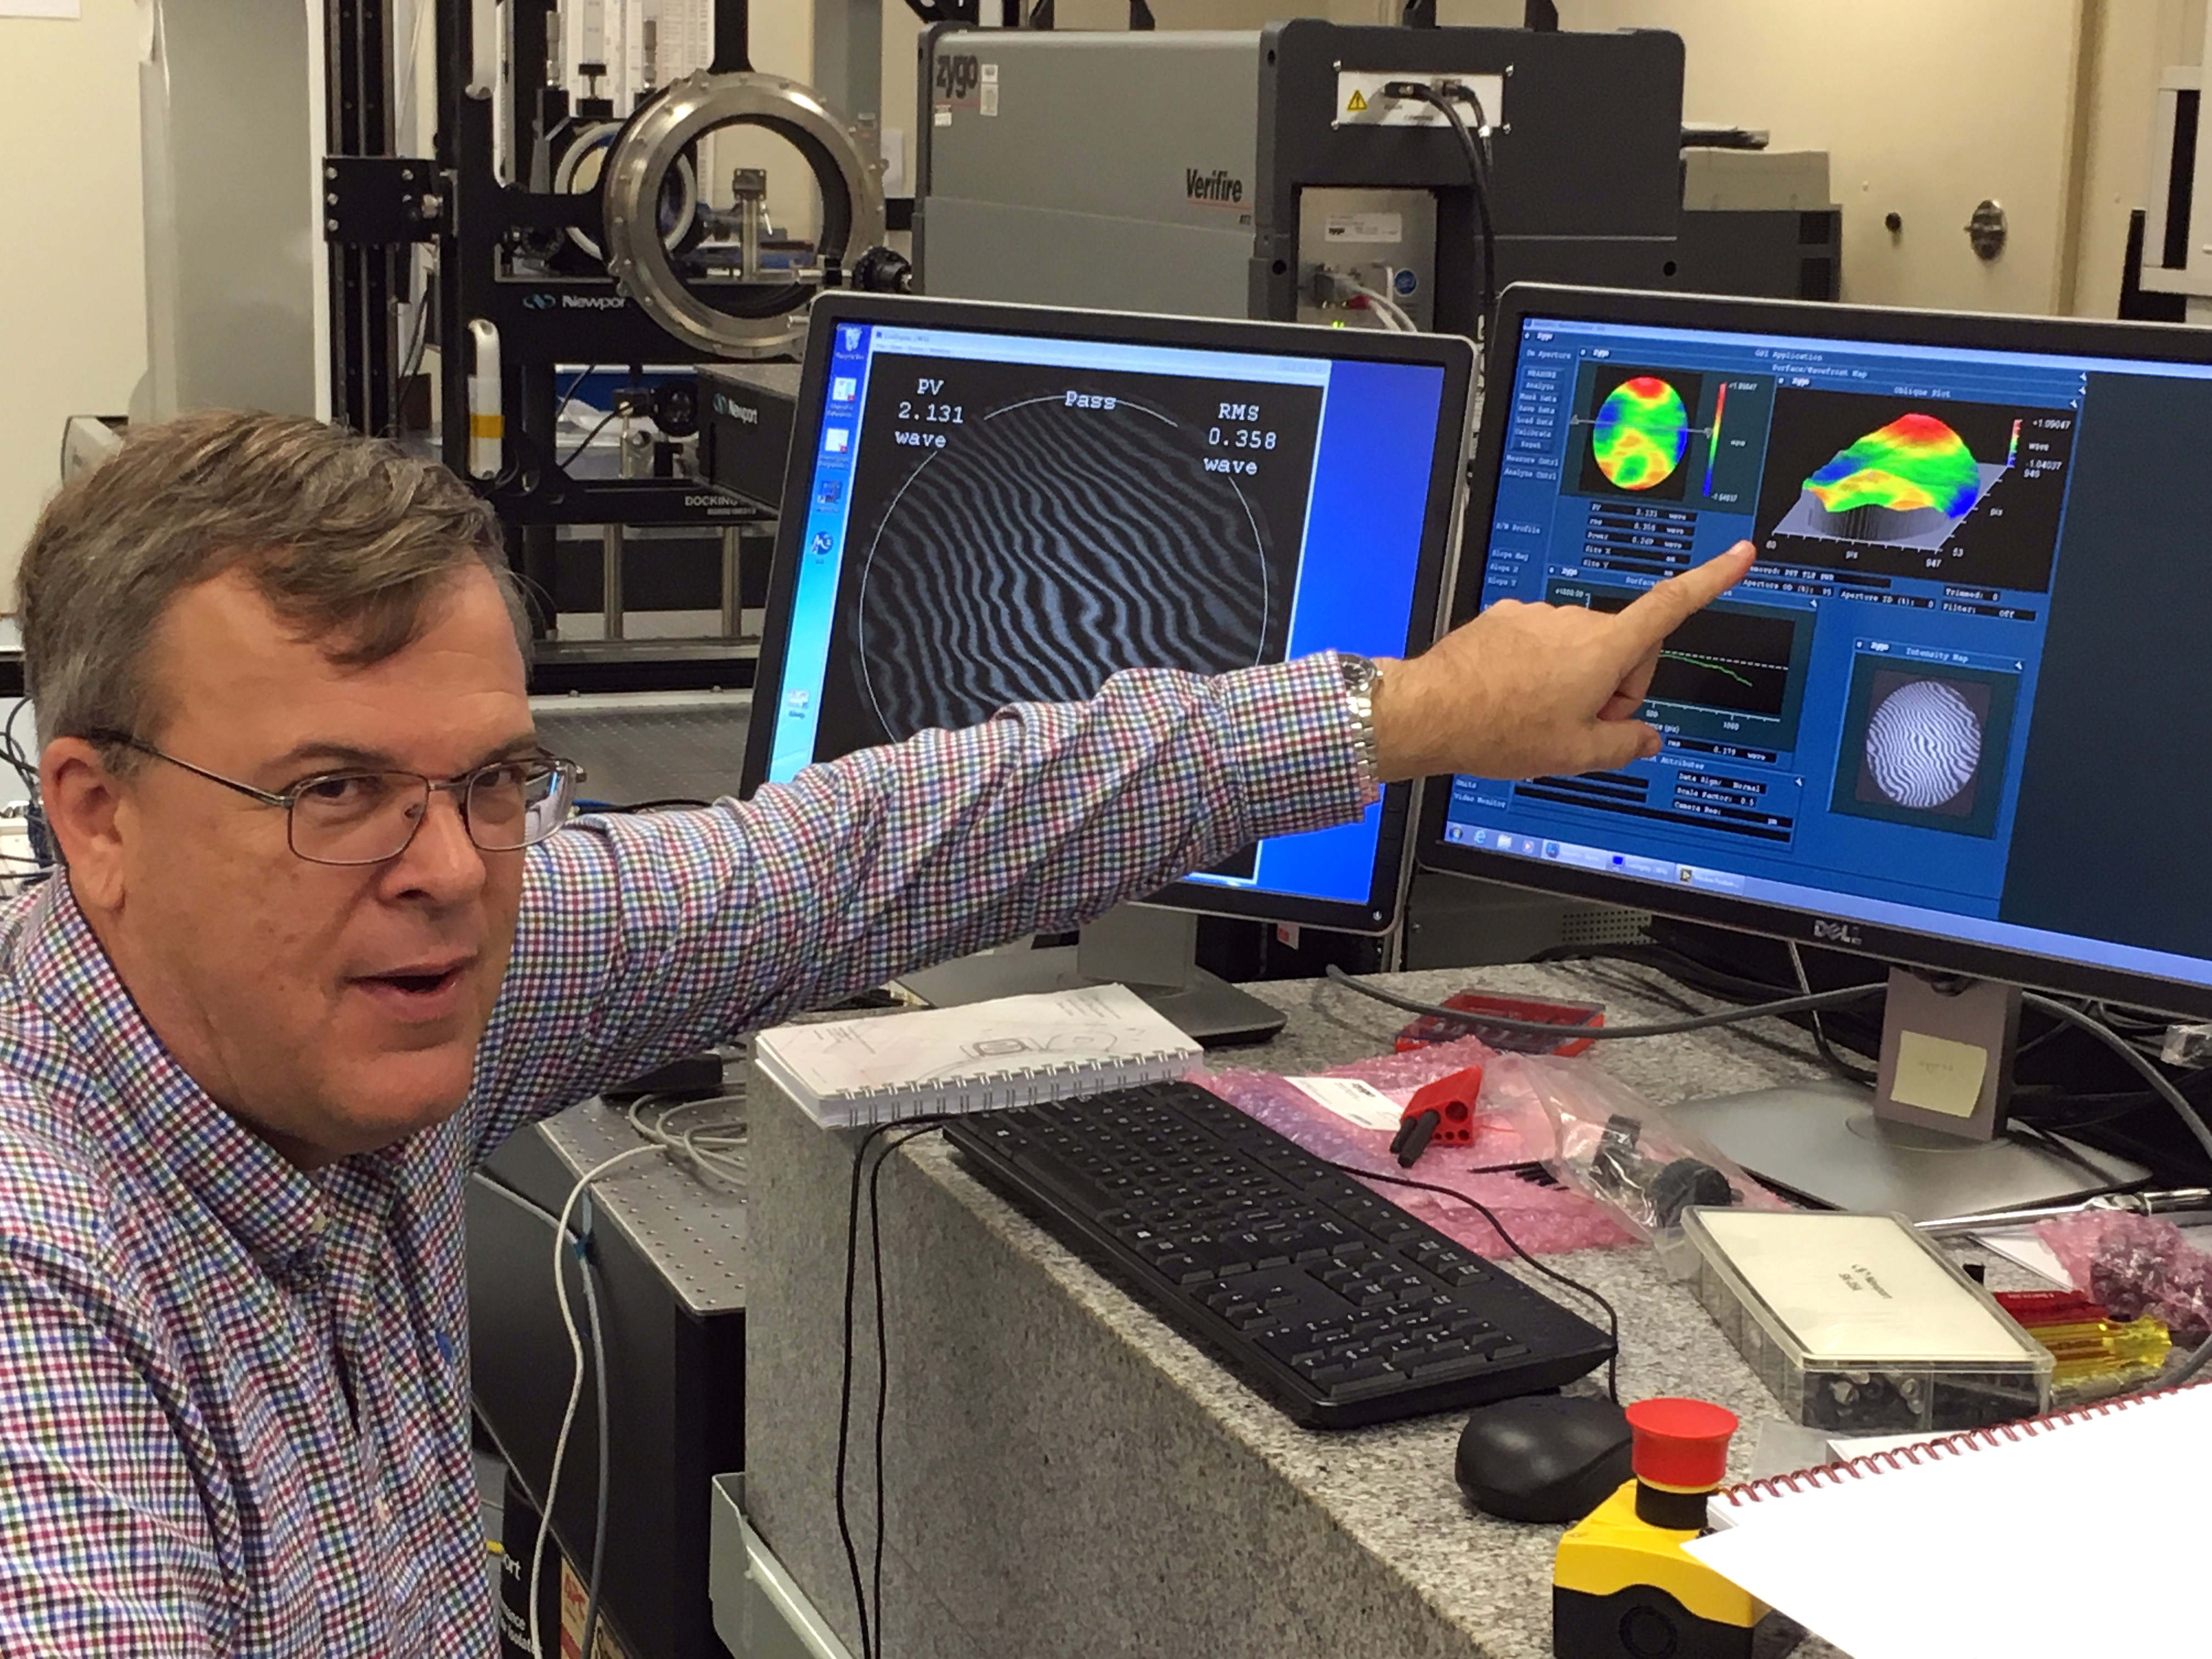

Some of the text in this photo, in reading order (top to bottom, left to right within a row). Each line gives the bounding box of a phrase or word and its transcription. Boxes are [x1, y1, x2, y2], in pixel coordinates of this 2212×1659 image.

[936, 54, 978, 99] zygo
[1187, 167, 1243, 204] Verifire
[562, 295, 625, 311] Newpor
[1773, 351, 1822, 362] Application
[917, 378, 944, 396] PV
[1894, 386, 1950, 398] Oblique Plot
[1065, 390, 1116, 410] Pass
[729, 399, 758, 424] Newport
[899, 401, 963, 424] 2.131
[1217, 403, 1260, 422] RMS
[894, 431, 946, 448] wave
[1209, 427, 1277, 450] 0.358
[2029, 443, 2049, 451] wave
[1204, 458, 1258, 475] wave
[1513, 524, 1541, 534] Profile
[1750, 566, 1780, 575] emoved:
[1742, 579, 1779, 589] Aperture
[1841, 590, 1878, 602] Aperture
[1946, 588, 1983, 600] Trimmed:
[1943, 602, 2015, 619] Filter: Off
[1906, 647, 1968, 664] Intensity Map
[1661, 757, 1705, 770] Attributes
[1747, 752, 1766, 760] wave
[1679, 772, 1697, 782] Data
[1733, 781, 1760, 793] Normal
[1454, 792, 1506, 809] Video Monitor
[1677, 787, 1699, 797] Scale
[1674, 802, 1701, 812] Camera
[1814, 919, 1862, 945] DELL
